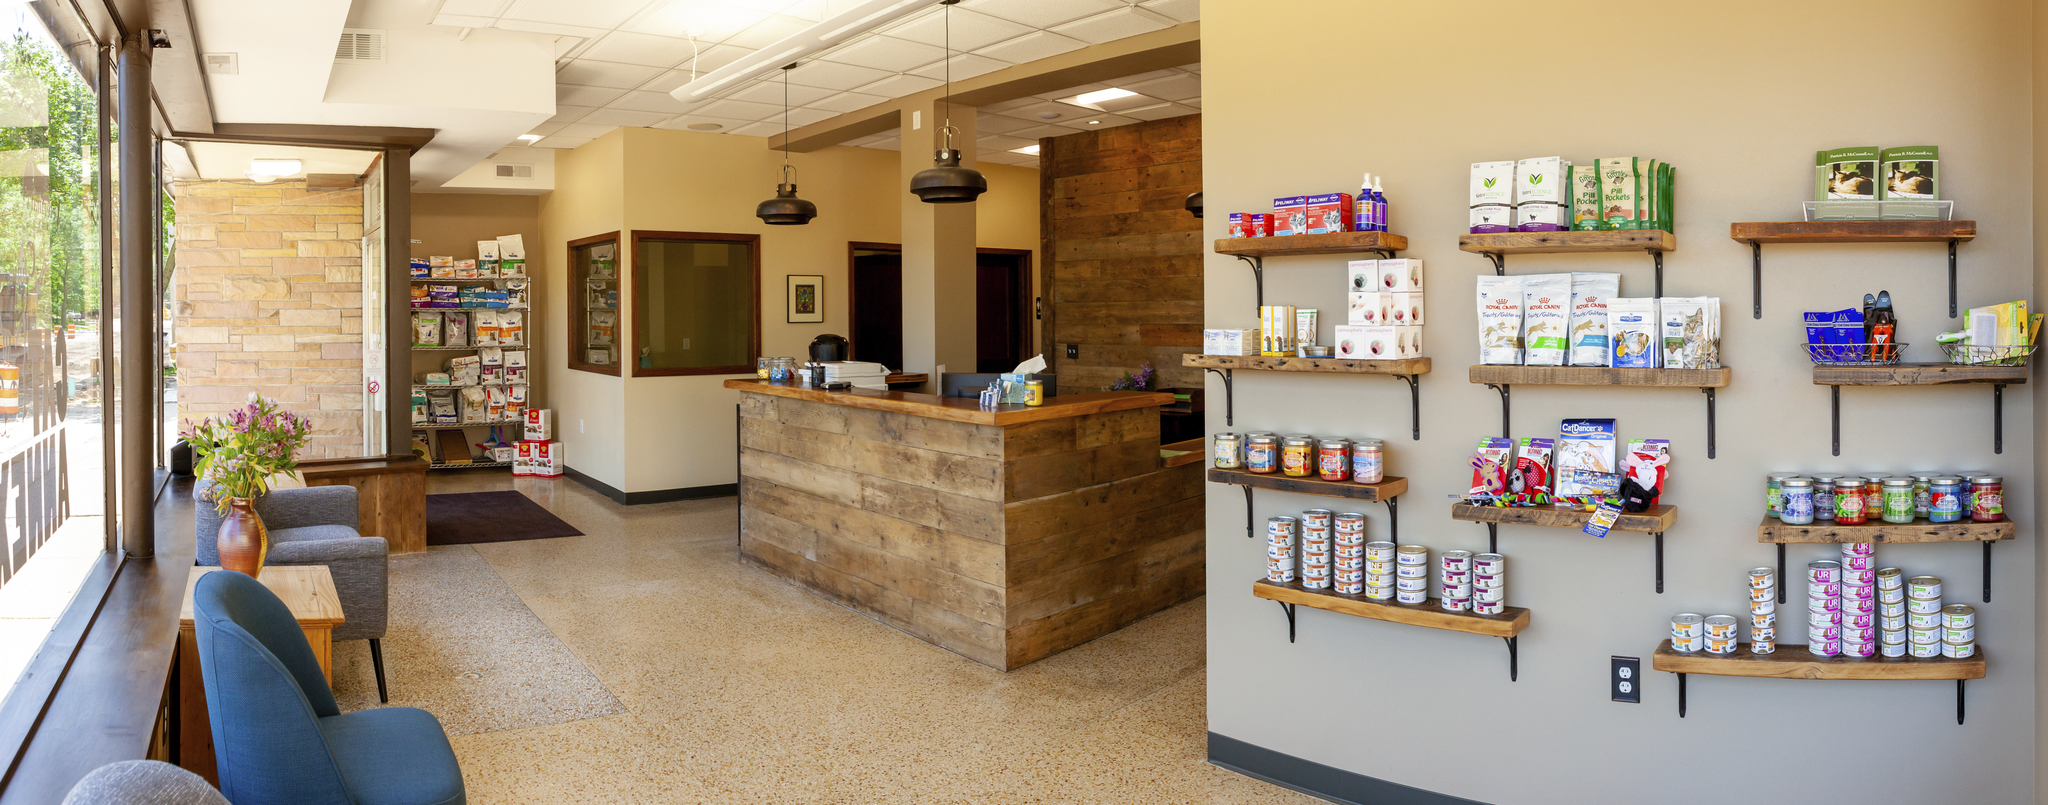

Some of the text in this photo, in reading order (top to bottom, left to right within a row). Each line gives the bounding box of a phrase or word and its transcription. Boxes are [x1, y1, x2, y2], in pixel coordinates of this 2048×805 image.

[1817, 570, 1829, 578] UR
[1863, 570, 1873, 578] UR
[1860, 586, 1871, 594] UR
[1828, 599, 1838, 607] UR
[1827, 628, 1838, 636] UR
[1864, 628, 1873, 636] UR
[1827, 642, 1838, 650] UR
